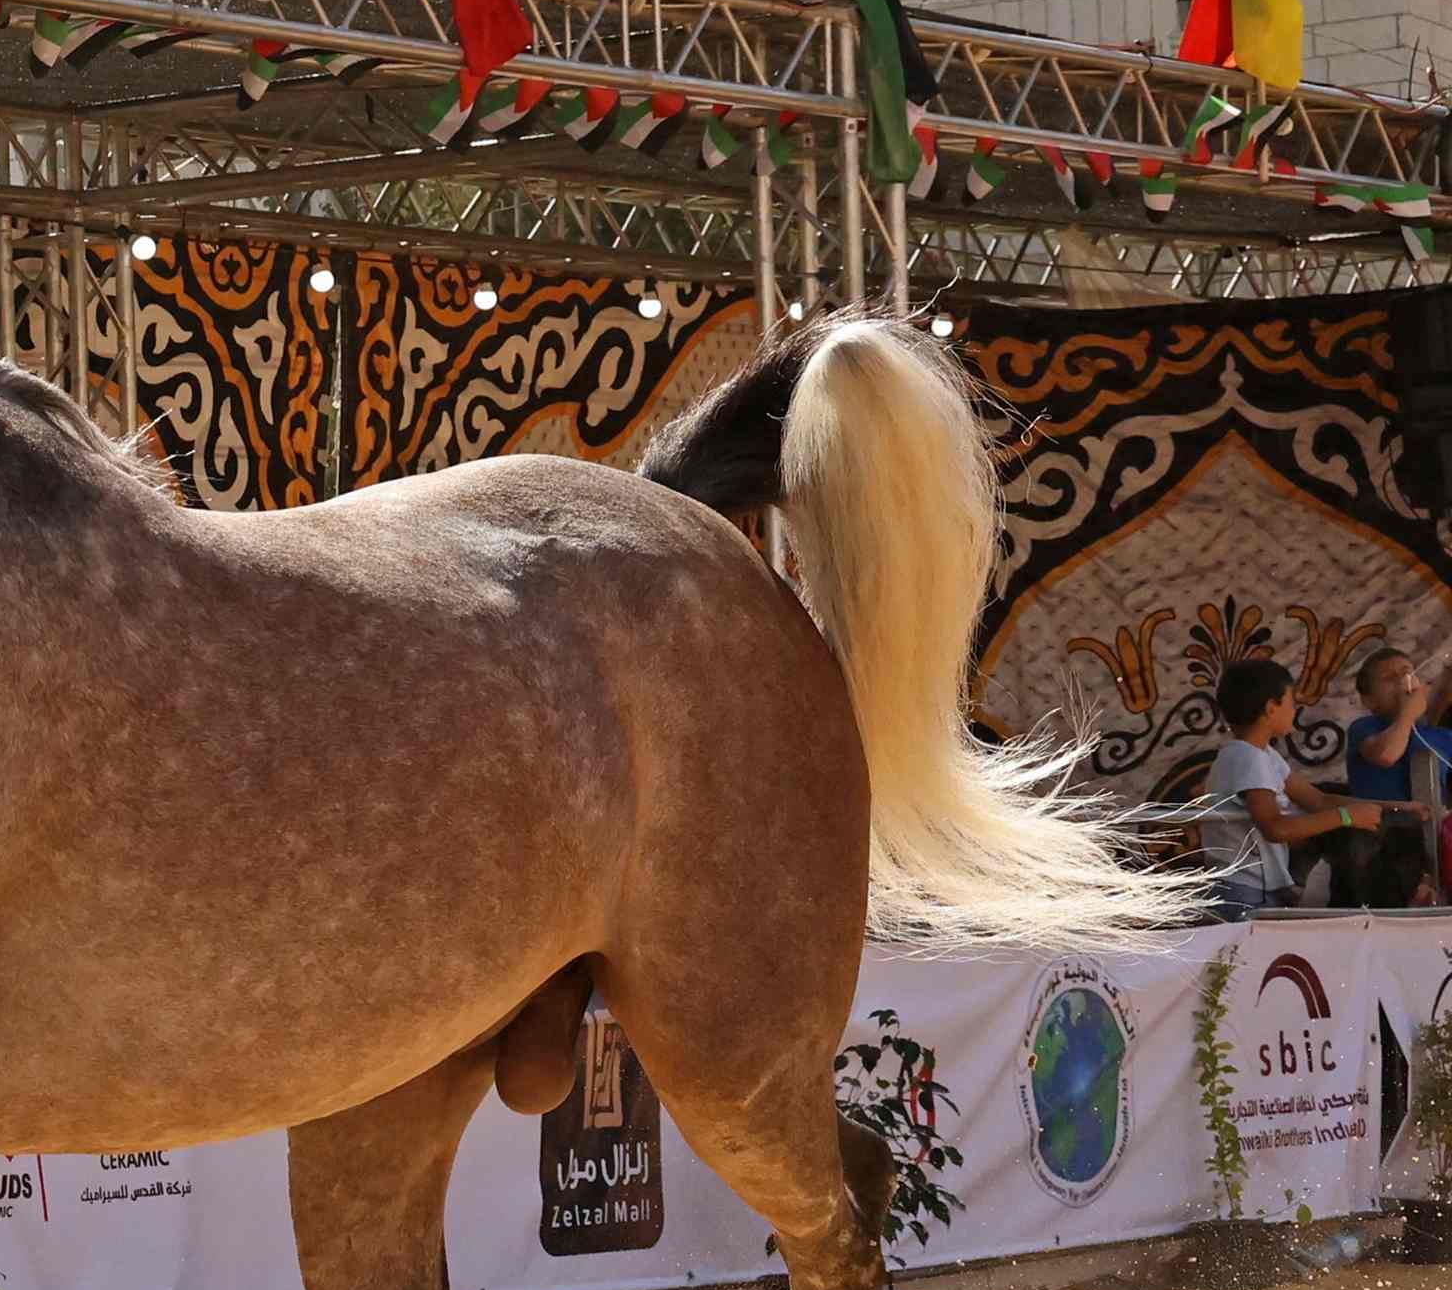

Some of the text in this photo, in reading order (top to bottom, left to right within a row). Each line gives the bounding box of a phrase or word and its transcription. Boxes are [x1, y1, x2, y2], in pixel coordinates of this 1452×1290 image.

[1259, 1029, 1337, 1077] sbic
[556, 1148, 597, 1191] مول
[551, 1198, 651, 1228] Zelzal Mall
